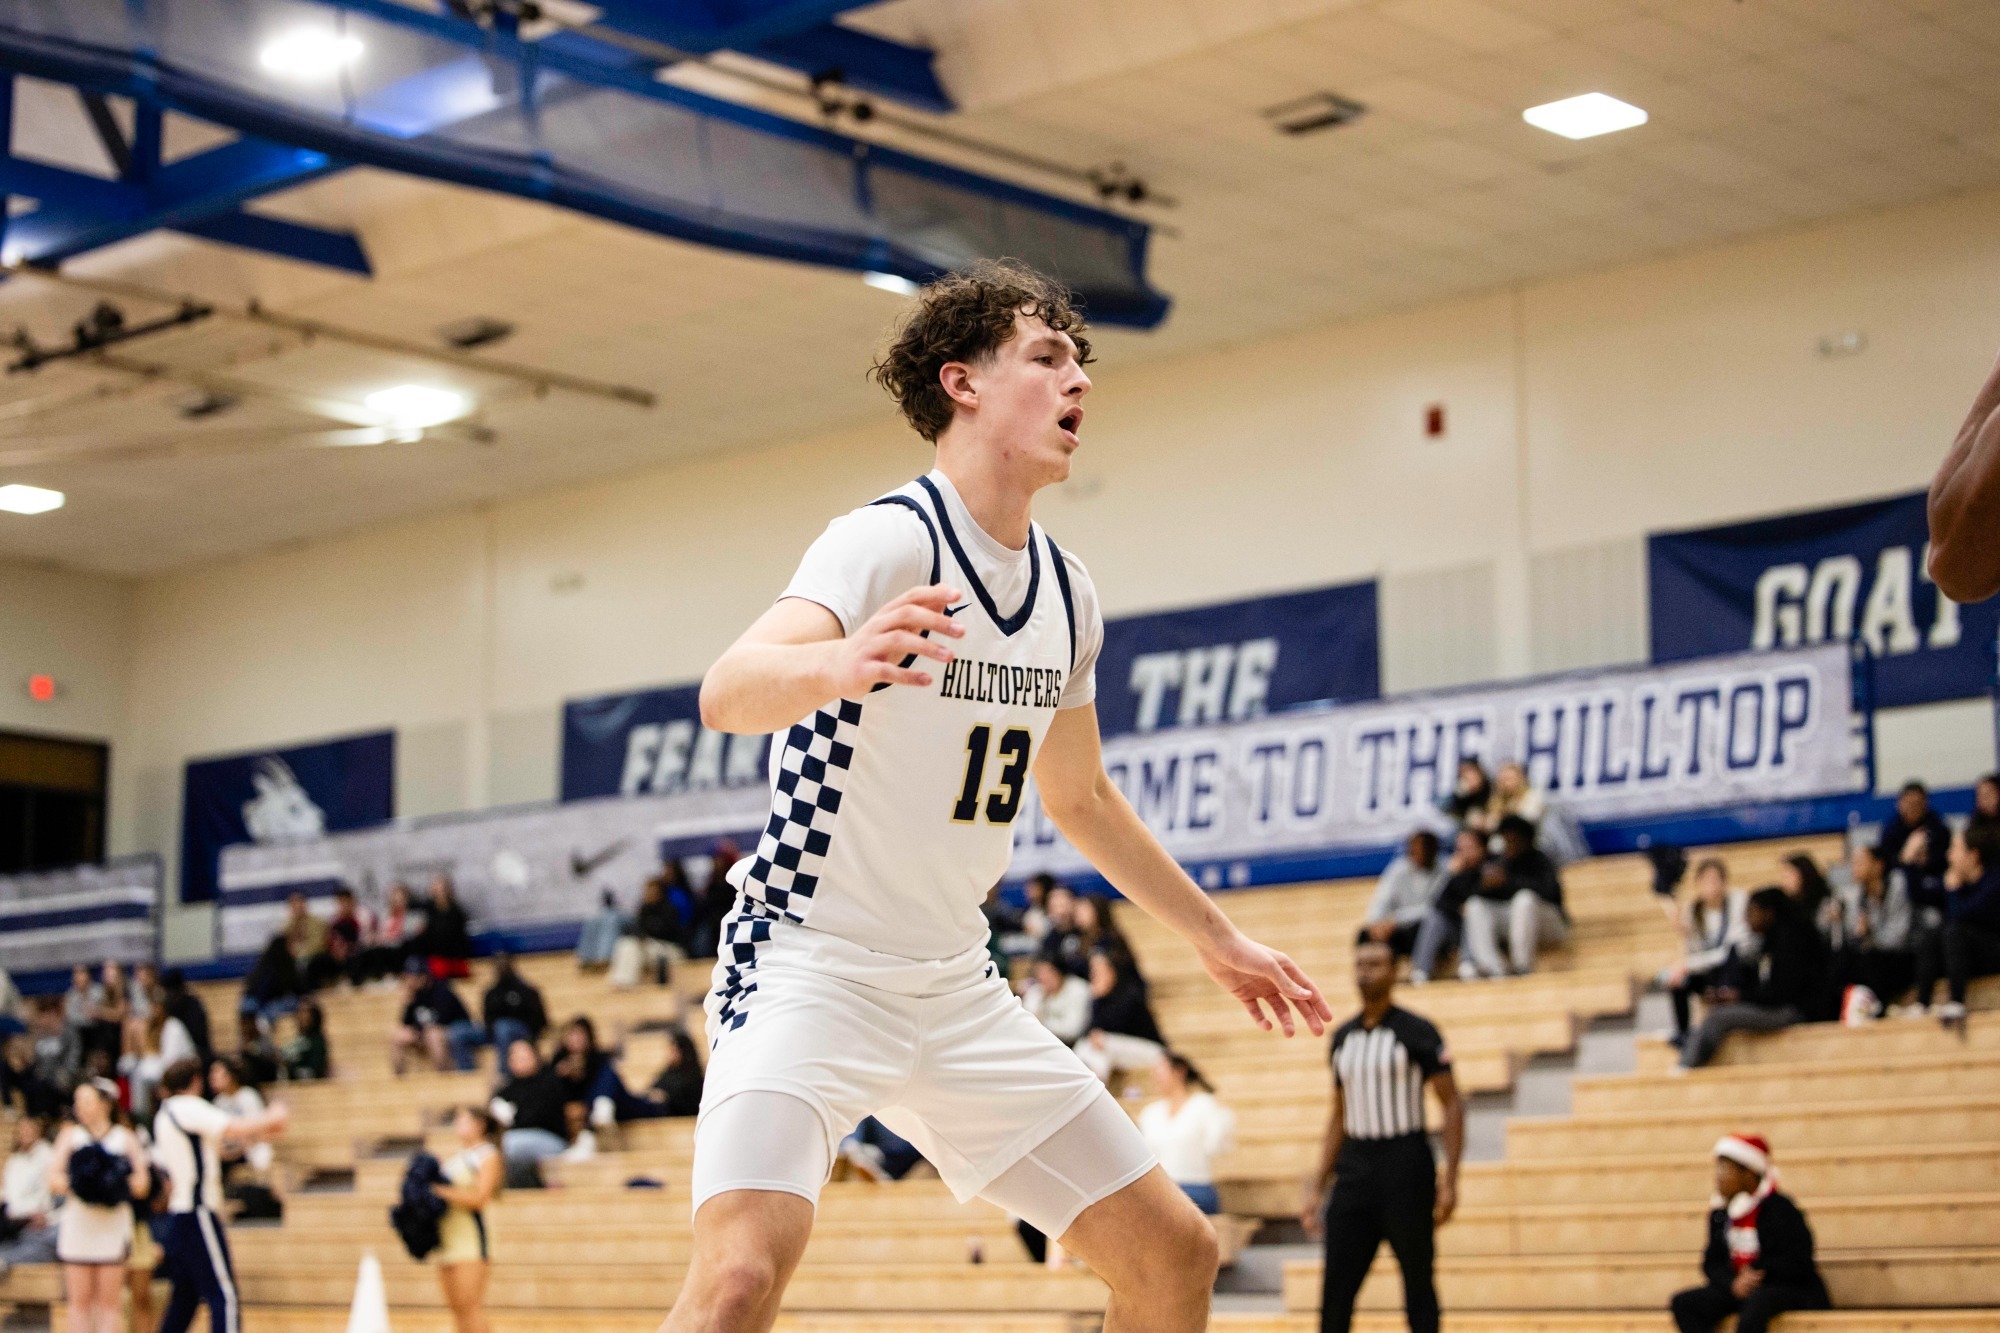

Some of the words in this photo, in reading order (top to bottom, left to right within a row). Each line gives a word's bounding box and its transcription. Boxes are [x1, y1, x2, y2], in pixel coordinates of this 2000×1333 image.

[1753, 543, 1962, 657] GOAT
[940, 658, 1062, 708] HILLTOPPERS
[1131, 637, 1279, 732] THE
[949, 721, 1033, 827] 13
[1255, 739, 1325, 823] TO
[1359, 718, 1484, 811] THE
[1524, 677, 1810, 790] HILLTOP
